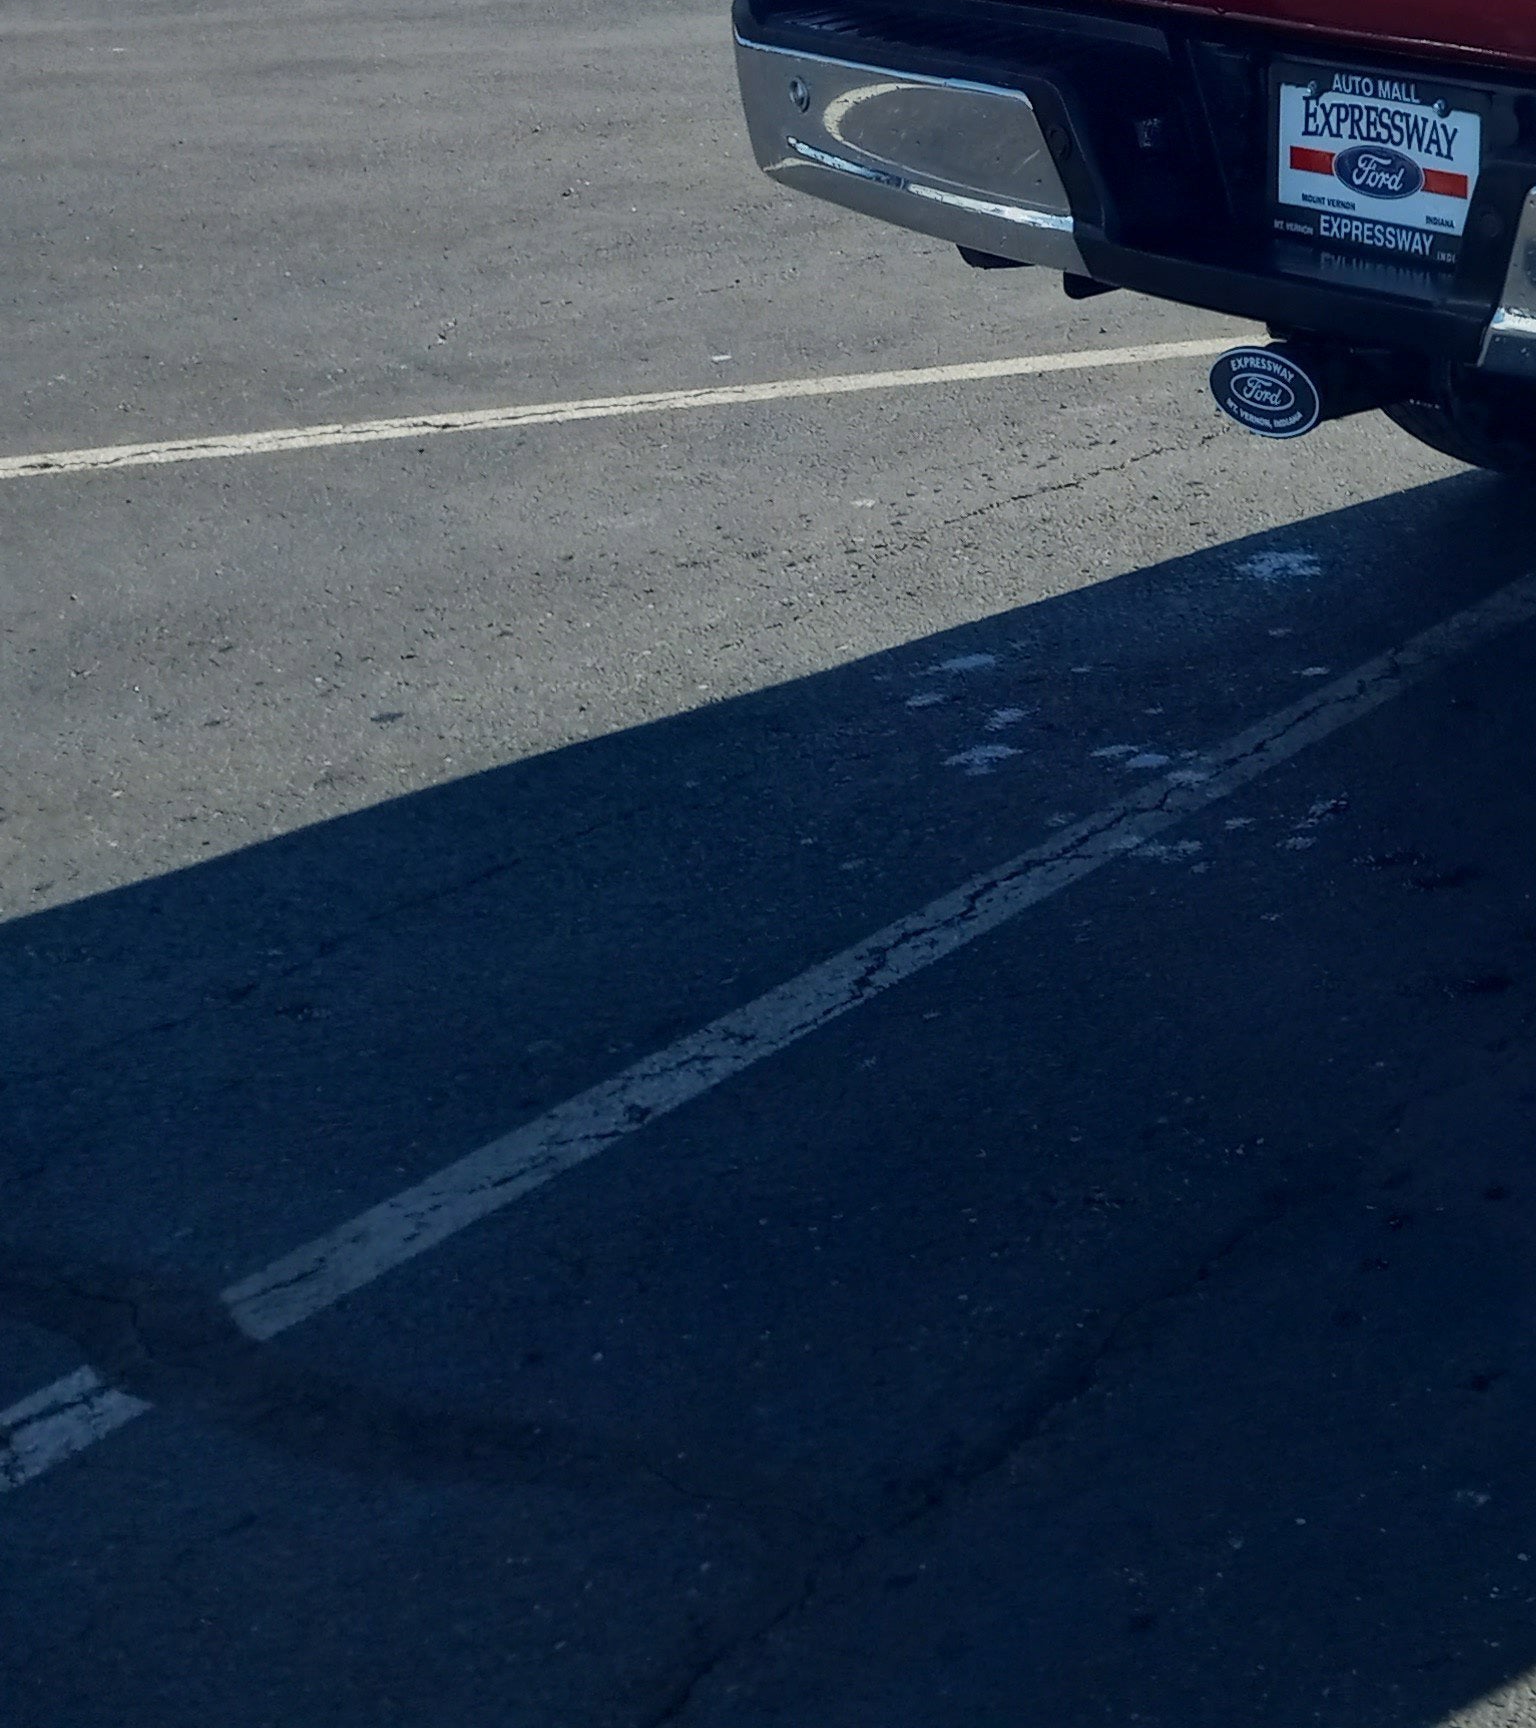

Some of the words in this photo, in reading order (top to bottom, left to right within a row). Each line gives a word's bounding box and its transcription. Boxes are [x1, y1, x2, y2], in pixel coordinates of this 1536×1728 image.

[1332, 73, 1374, 96] AUTO
[1378, 80, 1421, 104] MALL
[1301, 96, 1458, 162] EXPRESSWAY
[1352, 153, 1405, 192] Ford
[1327, 197, 1356, 211] VERNON
[1320, 214, 1434, 256] EXPRESSWAY
[1230, 356, 1294, 383] EXPRESSWAY
[1243, 377, 1283, 406] Ford
[1273, 411, 1303, 428] INDIANA
